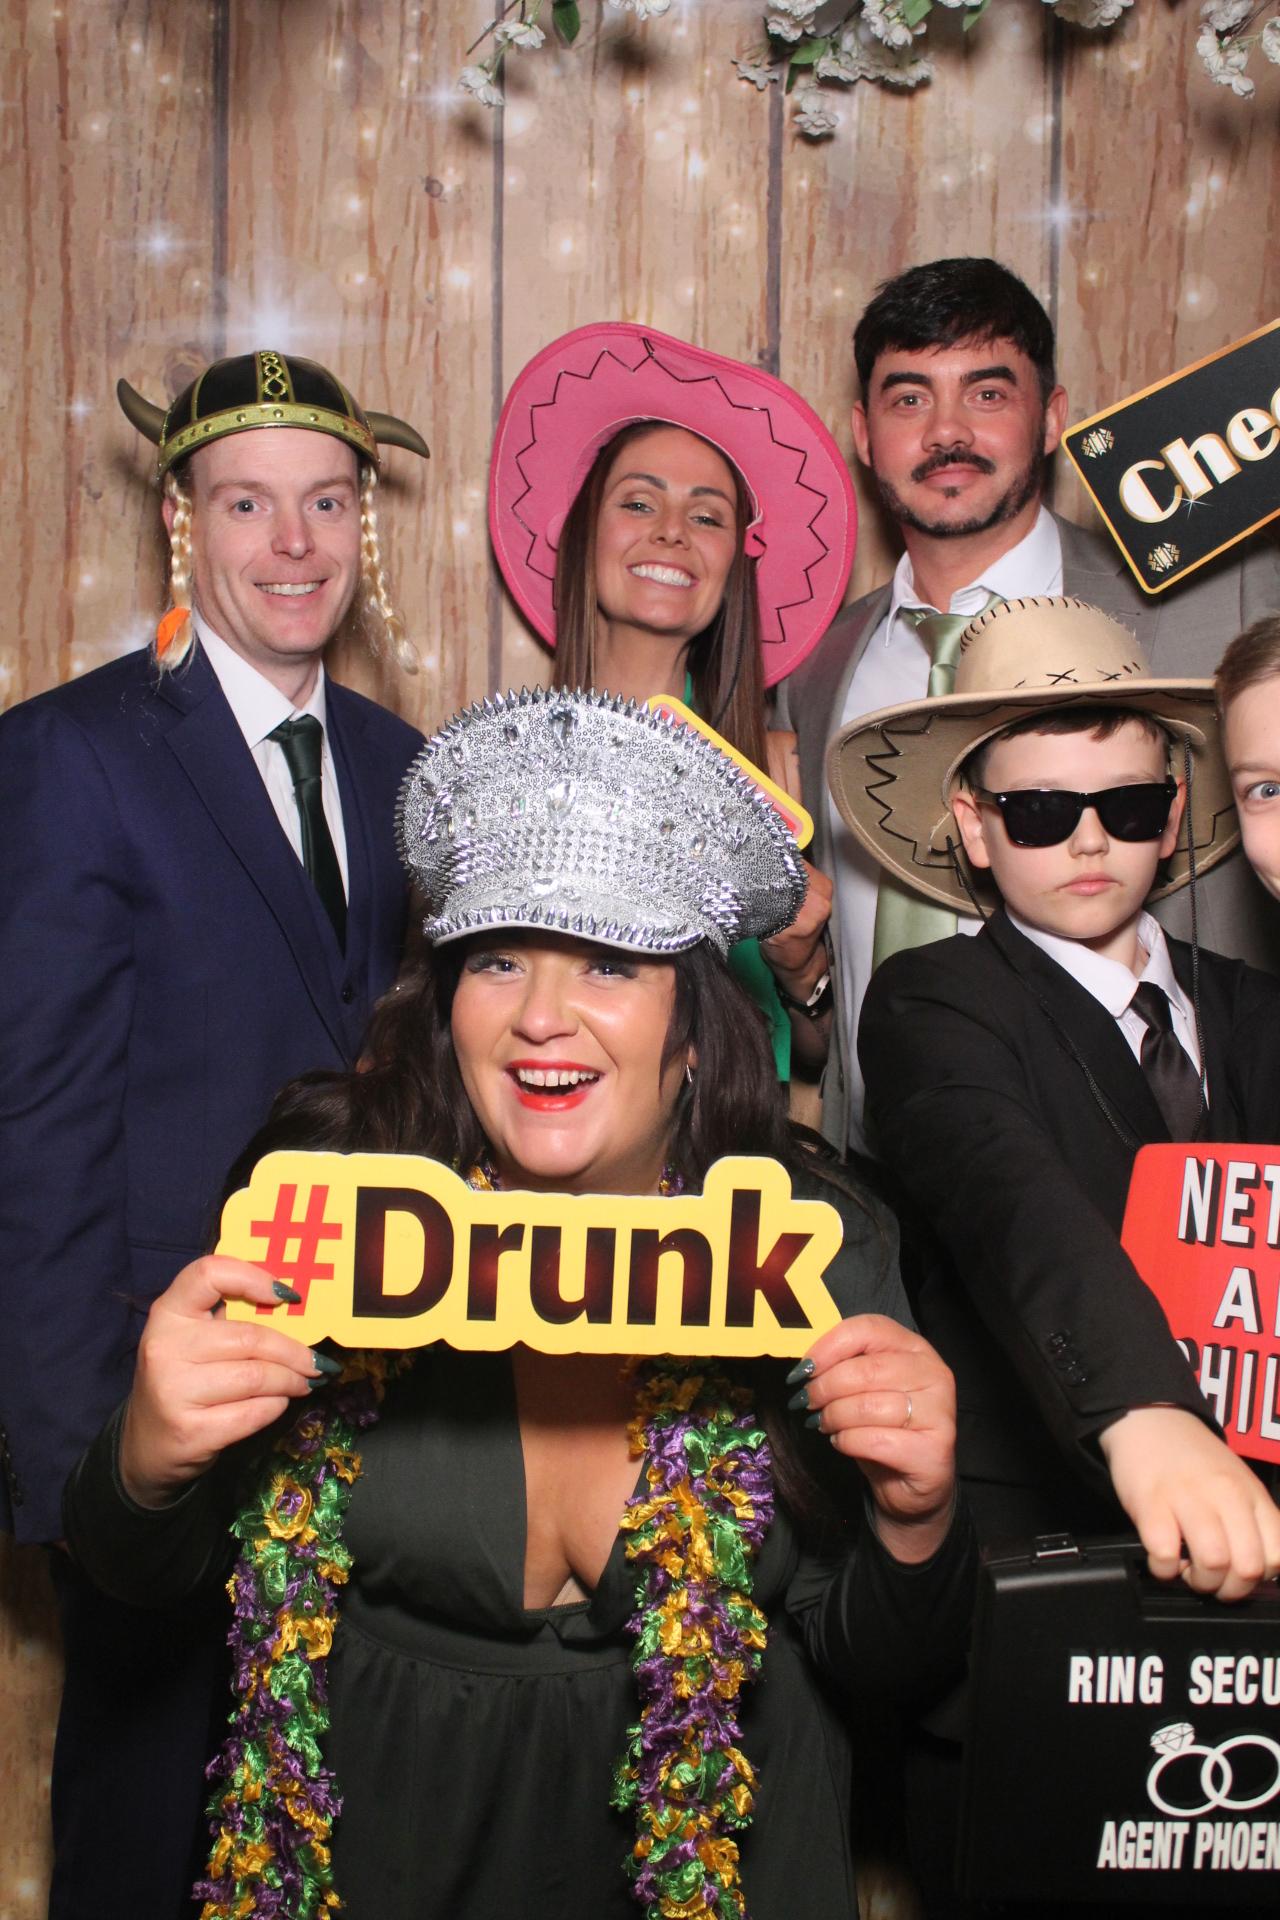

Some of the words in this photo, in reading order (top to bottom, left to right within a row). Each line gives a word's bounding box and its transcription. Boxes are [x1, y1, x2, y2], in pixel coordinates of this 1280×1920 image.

[1118, 385, 1280, 523] Che
[248, 1183, 814, 1329] #Drunk
[1212, 1265, 1280, 1337] A
[1175, 1337, 1280, 1441] HIL
[1068, 1655, 1164, 1704] RING
[1188, 1655, 1280, 1705] SECU
[1096, 1820, 1190, 1869] AGENT
[1193, 1821, 1280, 1871] PHOEN
